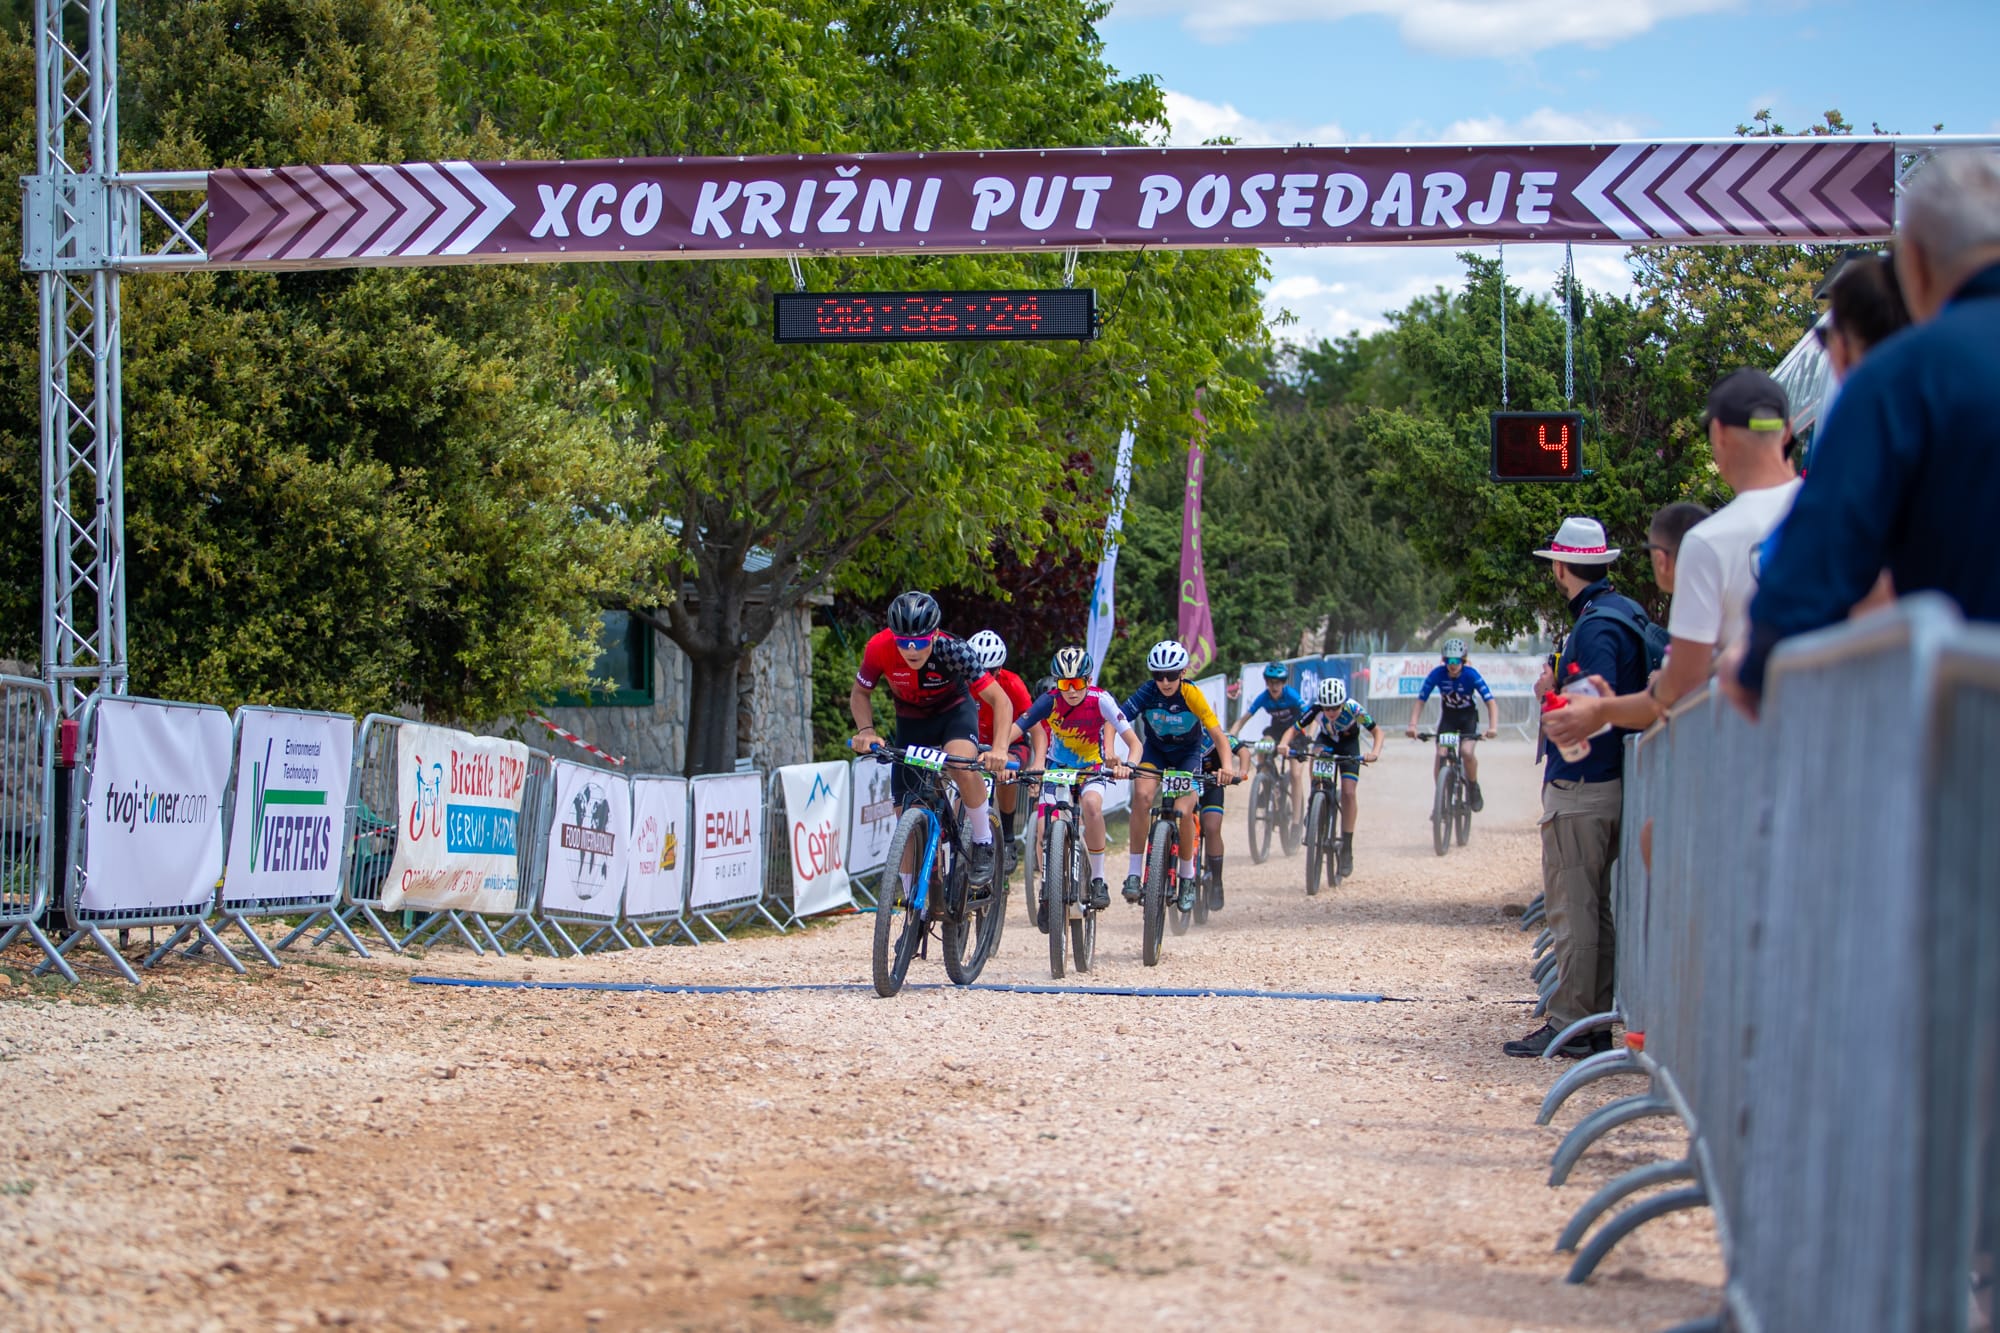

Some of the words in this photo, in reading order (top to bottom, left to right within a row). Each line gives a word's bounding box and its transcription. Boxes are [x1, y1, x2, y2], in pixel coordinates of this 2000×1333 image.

[530, 182, 663, 238] XCO
[691, 165, 942, 239] KRIŽNI
[971, 175, 1112, 231] PUT
[1138, 171, 1558, 230] POSEDARJE
[817, 297, 1043, 333] 00:36:24
[1539, 424, 1568, 470] 4
[285, 739, 322, 756] Environmental
[284, 763, 311, 784] Technology
[312, 763, 320, 784] by
[450, 750, 494, 797] Bicikle
[1166, 777, 1191, 791] 103
[1315, 761, 1334, 773] 106
[106, 779, 207, 833] tvoj-toner.com
[263, 815, 330, 872] VERTEKS
[450, 811, 486, 848] SERVIS
[565, 826, 581, 848] FOOD
[705, 809, 752, 849] ERALA
